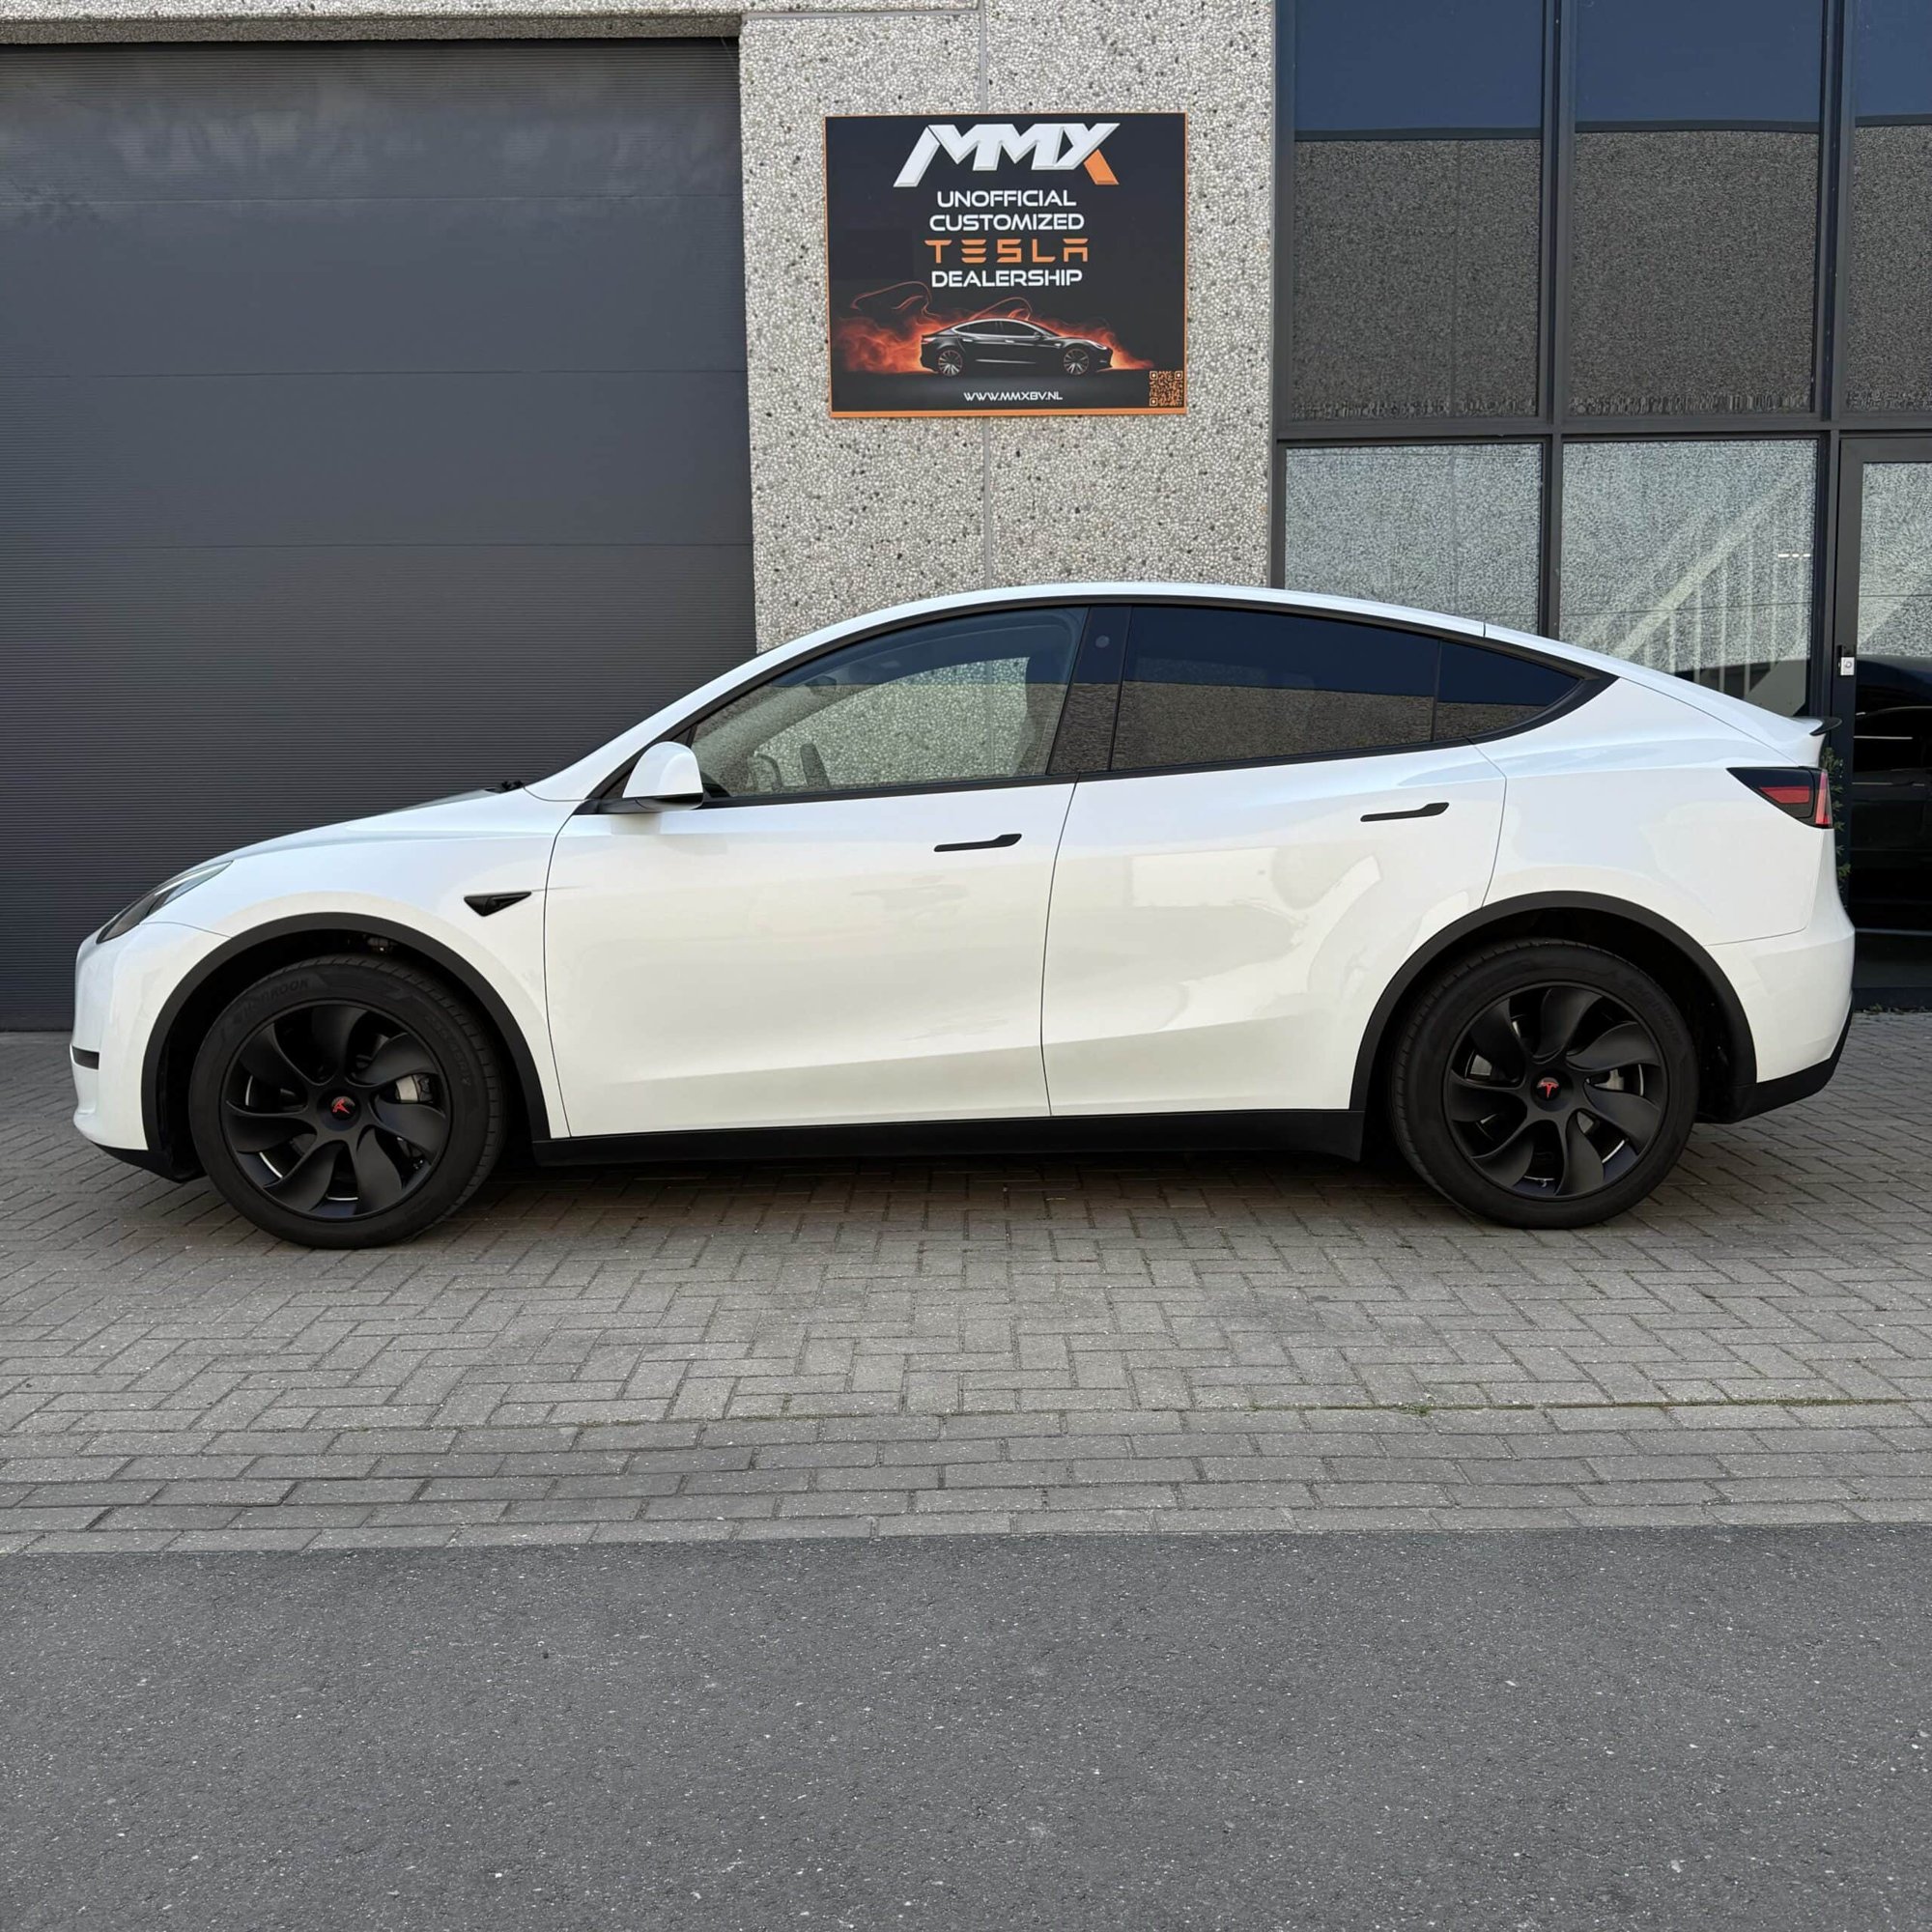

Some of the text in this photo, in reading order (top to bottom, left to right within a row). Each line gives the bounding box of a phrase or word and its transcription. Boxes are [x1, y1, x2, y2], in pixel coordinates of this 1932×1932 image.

[894, 123, 1120, 187] MMX
[937, 190, 1076, 208] UNOFFICIAL
[929, 213, 1084, 232] CUSTOMIZED
[924, 239, 1088, 263] TESLA
[932, 270, 1082, 287] DEALERSHIP
[964, 391, 1063, 401] WWW.MMXBV.NL
